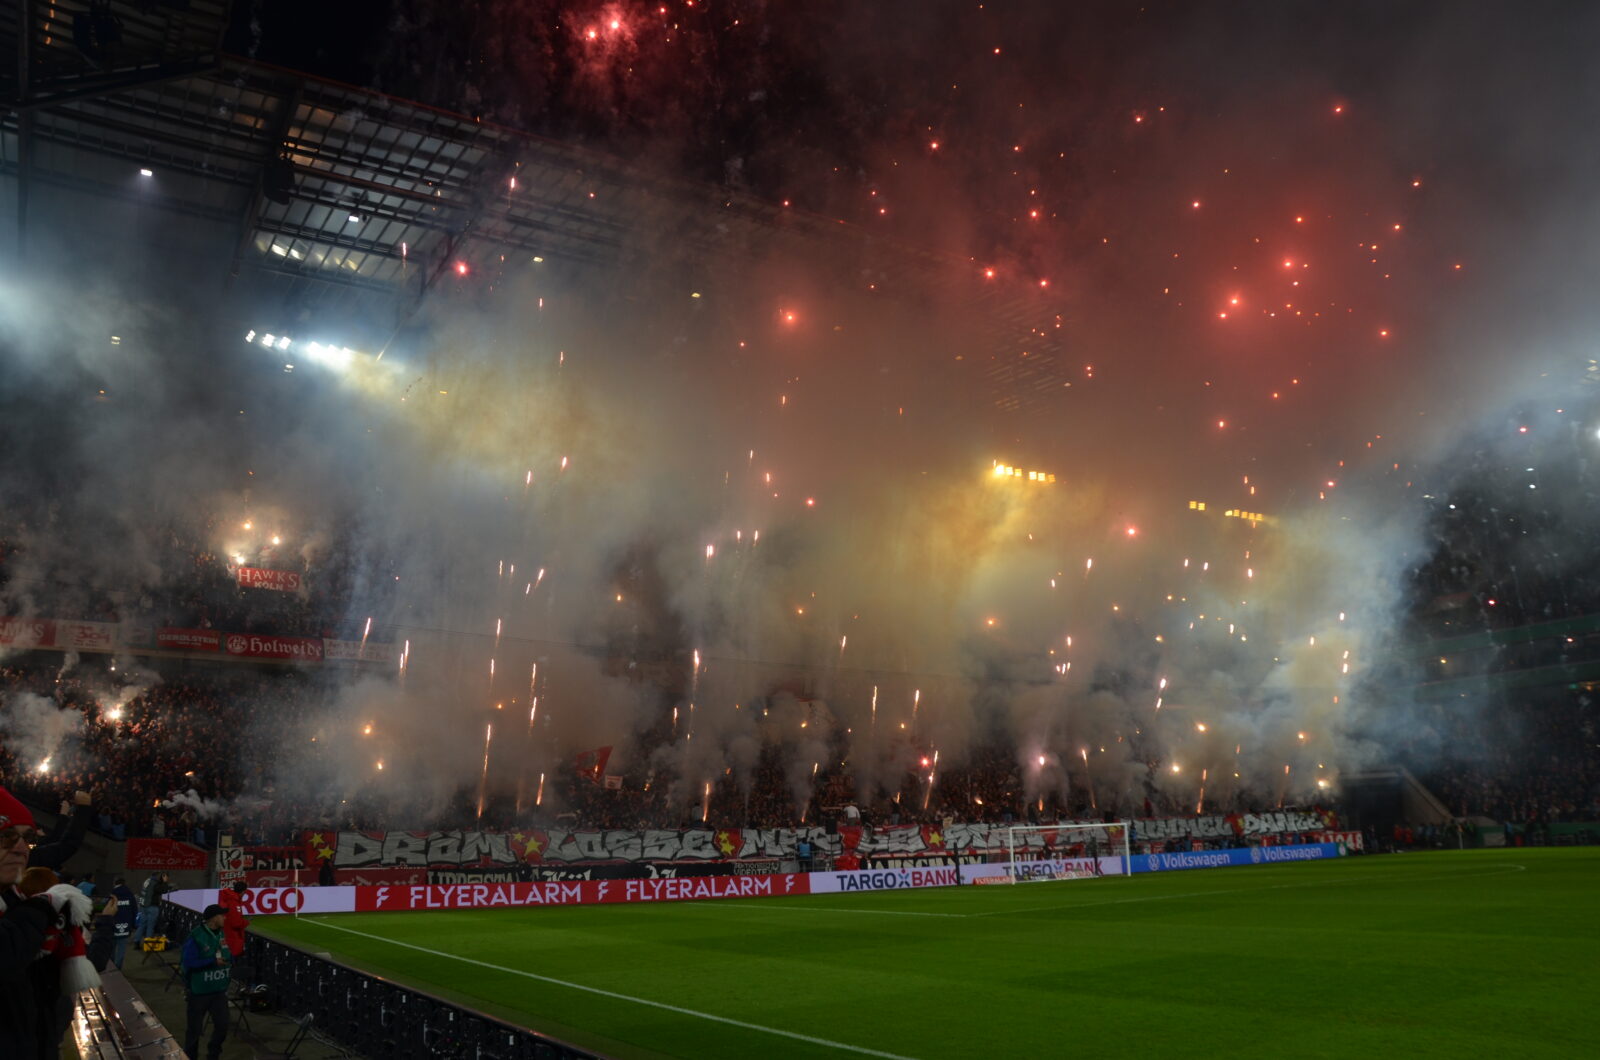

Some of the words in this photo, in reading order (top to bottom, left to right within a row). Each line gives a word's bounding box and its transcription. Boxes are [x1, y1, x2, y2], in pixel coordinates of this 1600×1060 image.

[238, 568, 298, 589] HAWKS
[254, 580, 284, 591] KÖLN
[1163, 852, 1231, 869] Volkswagen
[1263, 845, 1323, 861] Volkswagen
[219, 887, 305, 915] RGO
[410, 883, 582, 908] FLYERALARM
[626, 876, 772, 901] FLYERALARM
[204, 968, 231, 982] HOST
